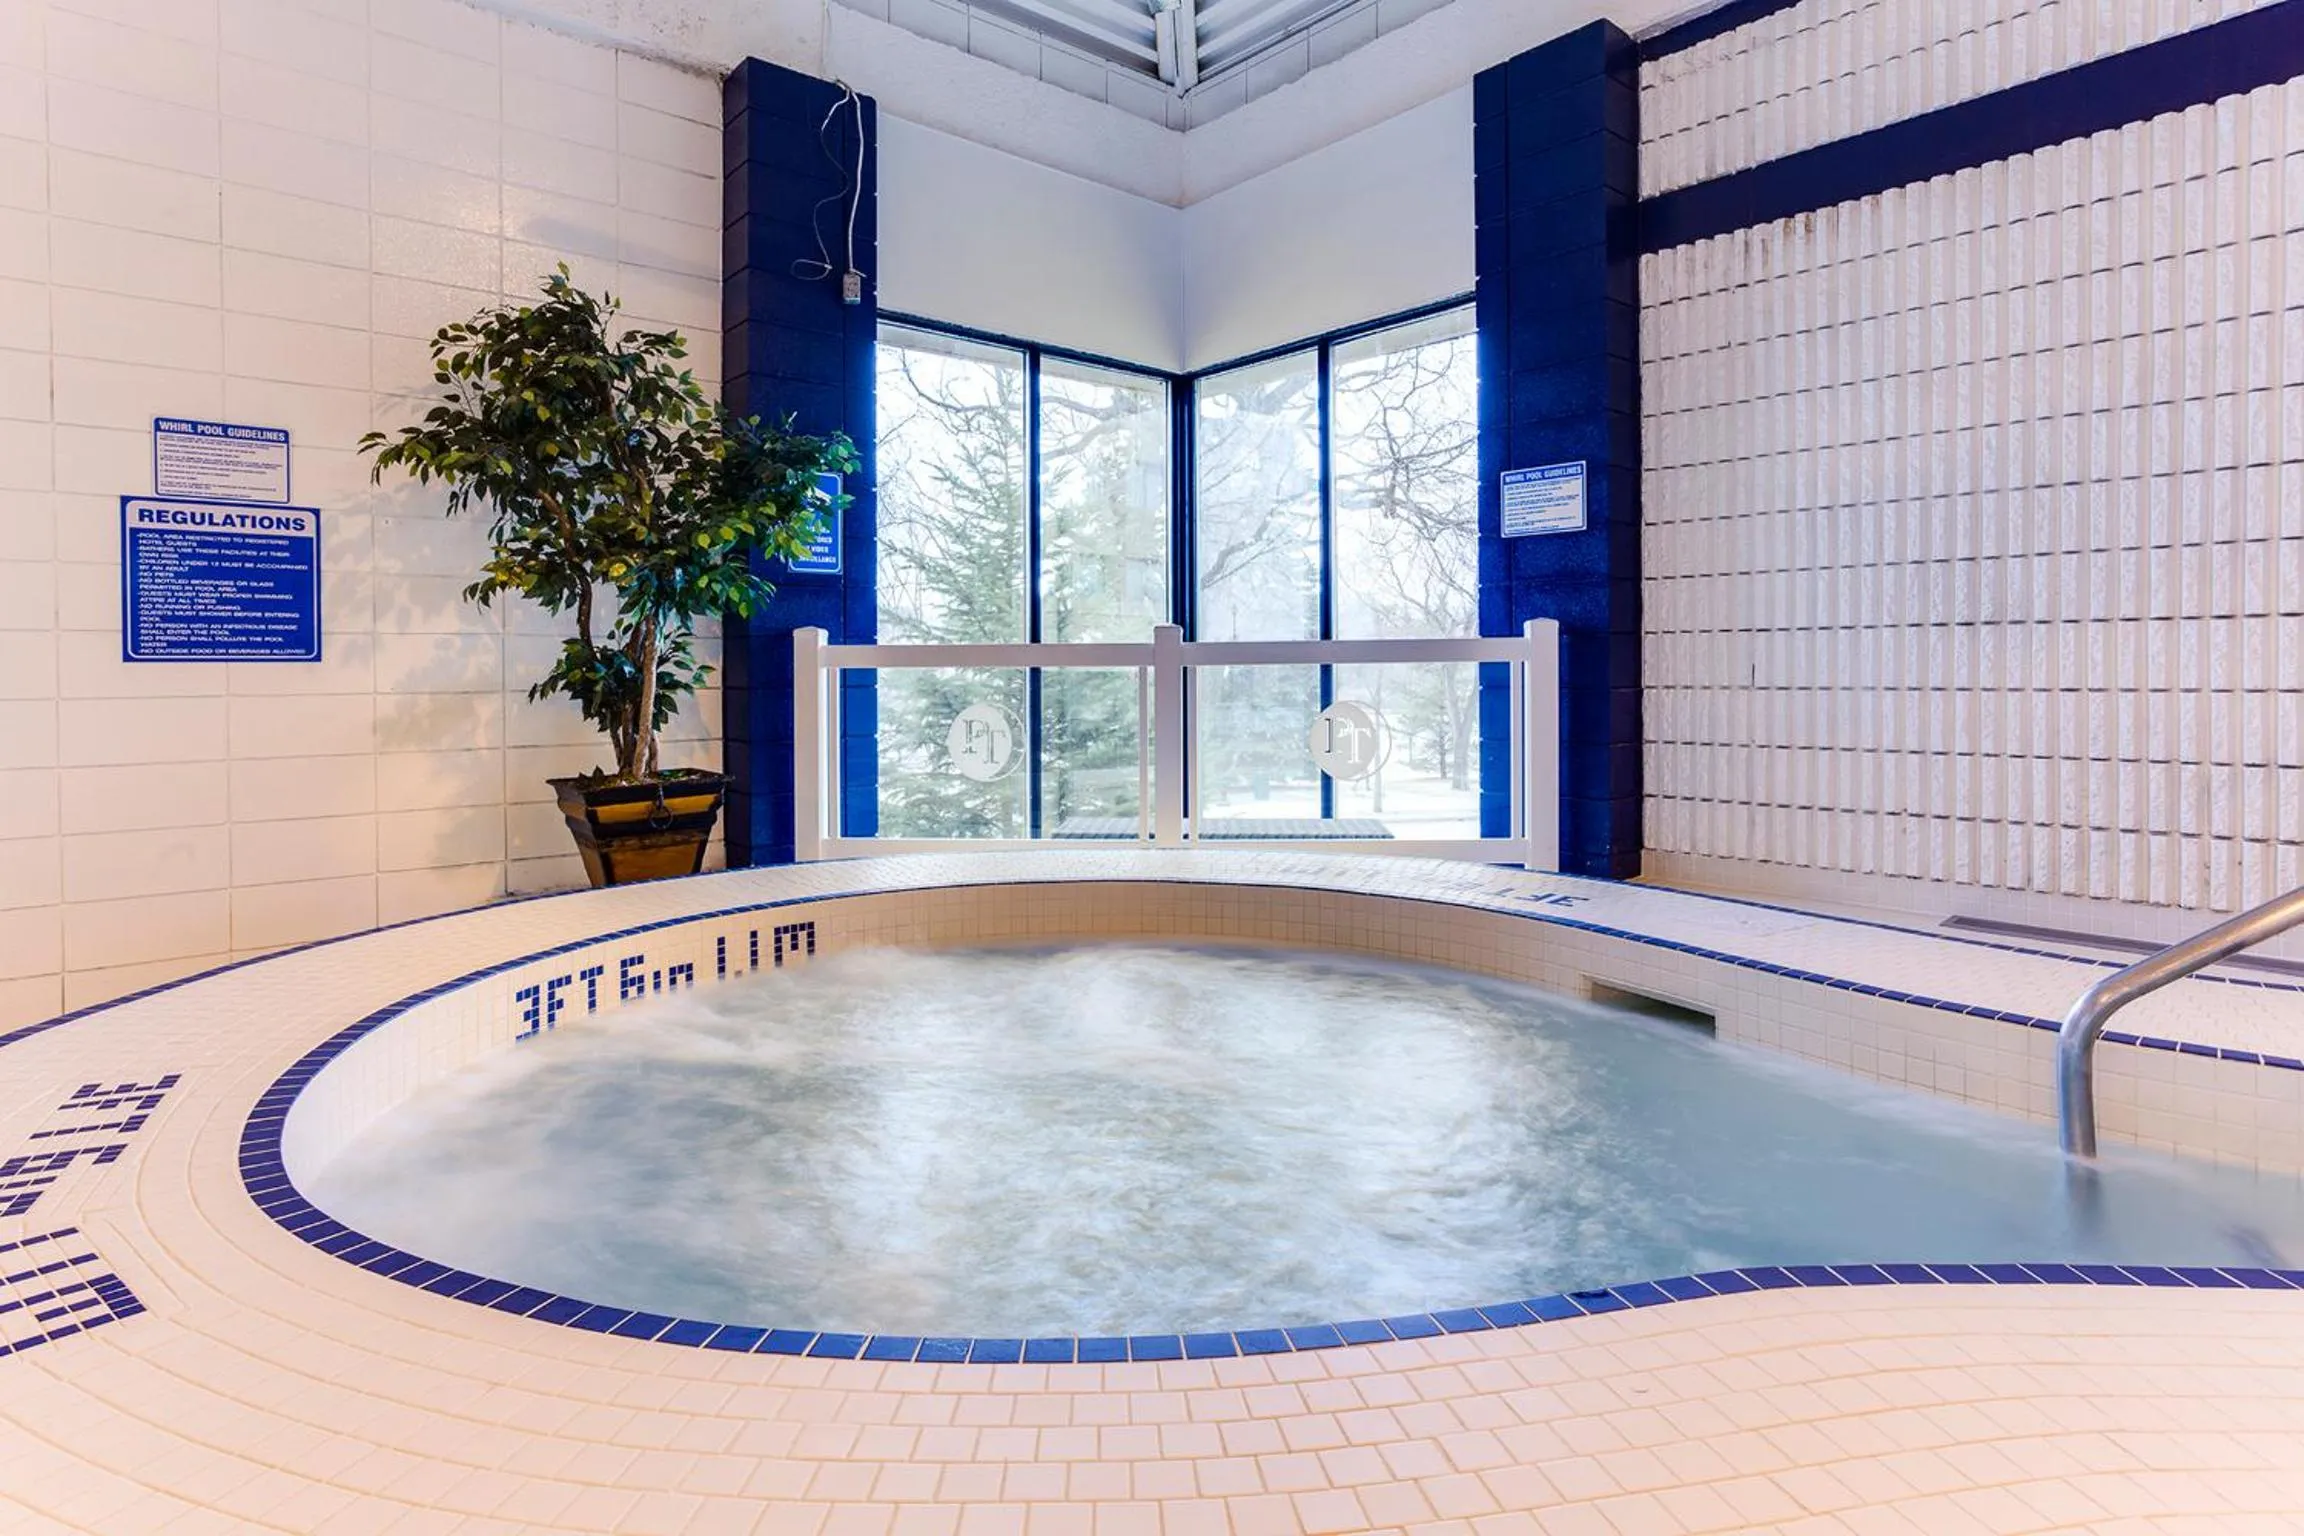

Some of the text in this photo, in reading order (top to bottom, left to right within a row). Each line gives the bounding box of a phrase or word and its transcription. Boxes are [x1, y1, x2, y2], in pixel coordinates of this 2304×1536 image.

[160, 421, 285, 441] WHIRL POOL GUIDELINES
[137, 508, 305, 531] REGULATIONS
